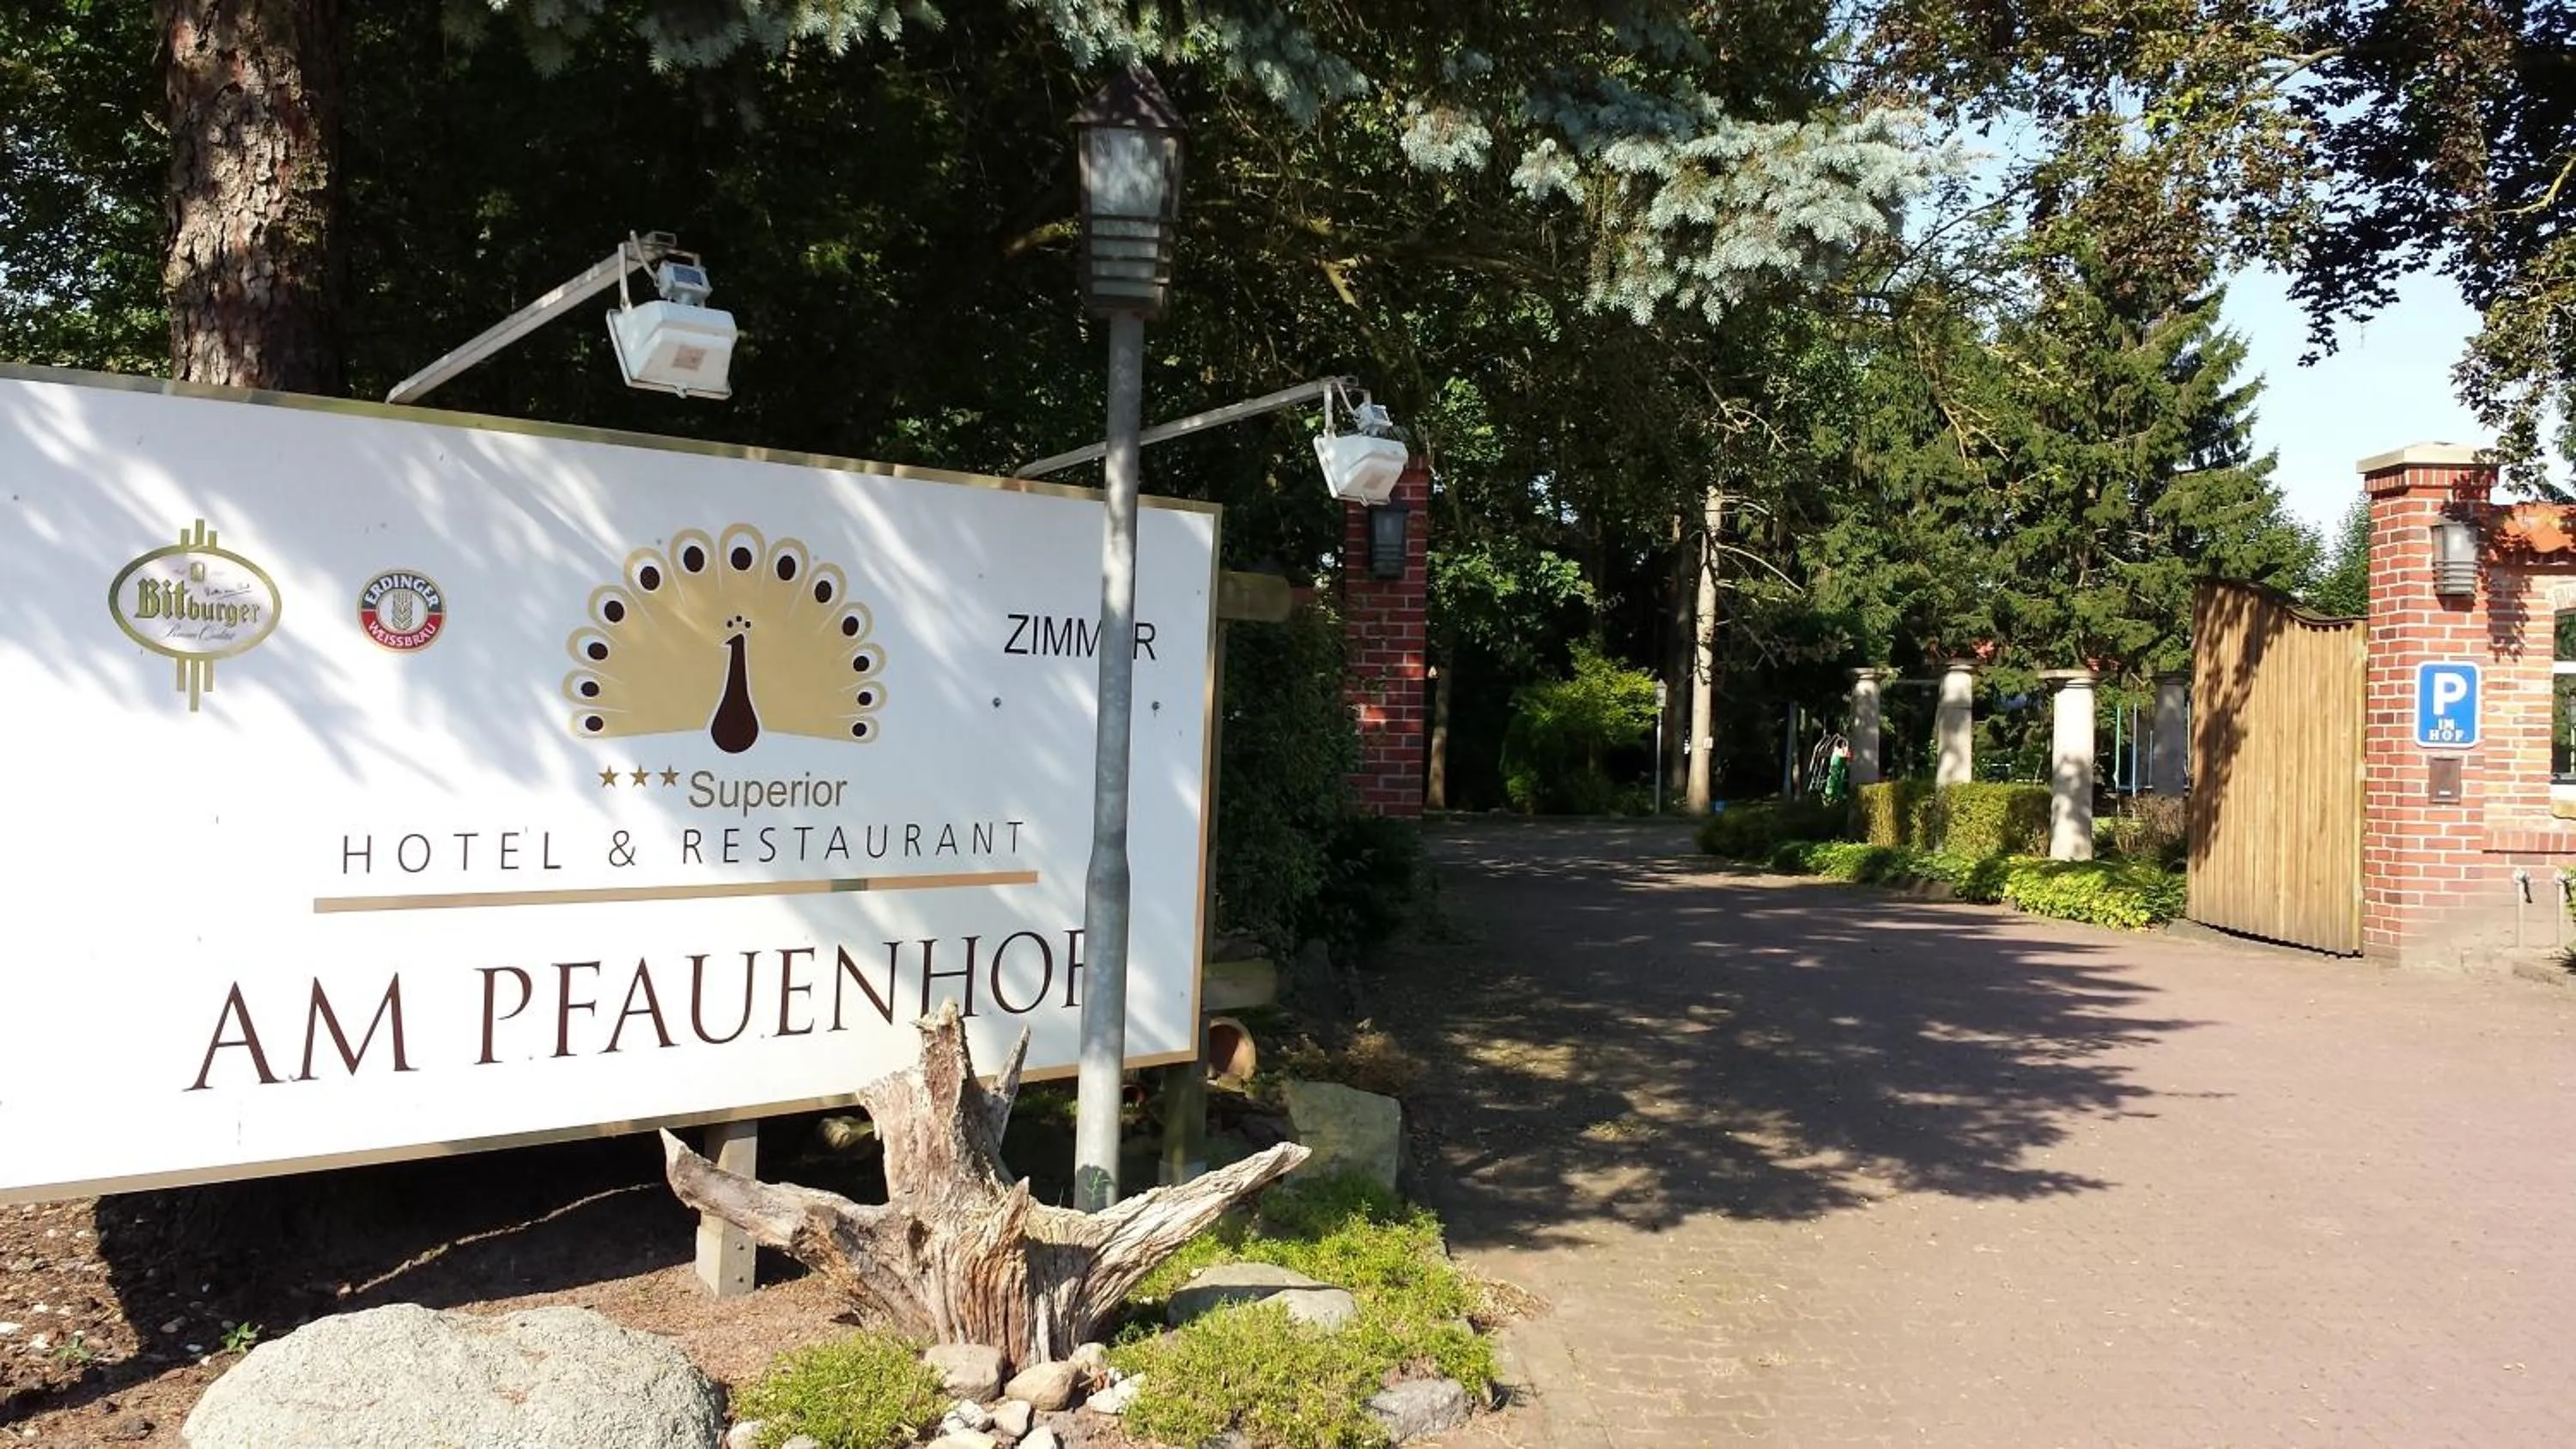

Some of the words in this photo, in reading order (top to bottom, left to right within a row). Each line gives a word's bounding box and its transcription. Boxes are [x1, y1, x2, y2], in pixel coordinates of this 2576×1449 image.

[134, 578, 260, 628] Bitburger
[364, 574, 440, 607] ERDINGER
[1004, 613, 1157, 660] ZIMMR
[2433, 672, 2468, 716] P
[2428, 729, 2465, 742] HOF
[2438, 718, 2456, 731] IM
[689, 770, 848, 817] Superior
[342, 830, 562, 875] HOTEL
[609, 829, 638, 868] &
[683, 822, 1024, 864] RESTAURANT
[182, 972, 420, 1092] AM
